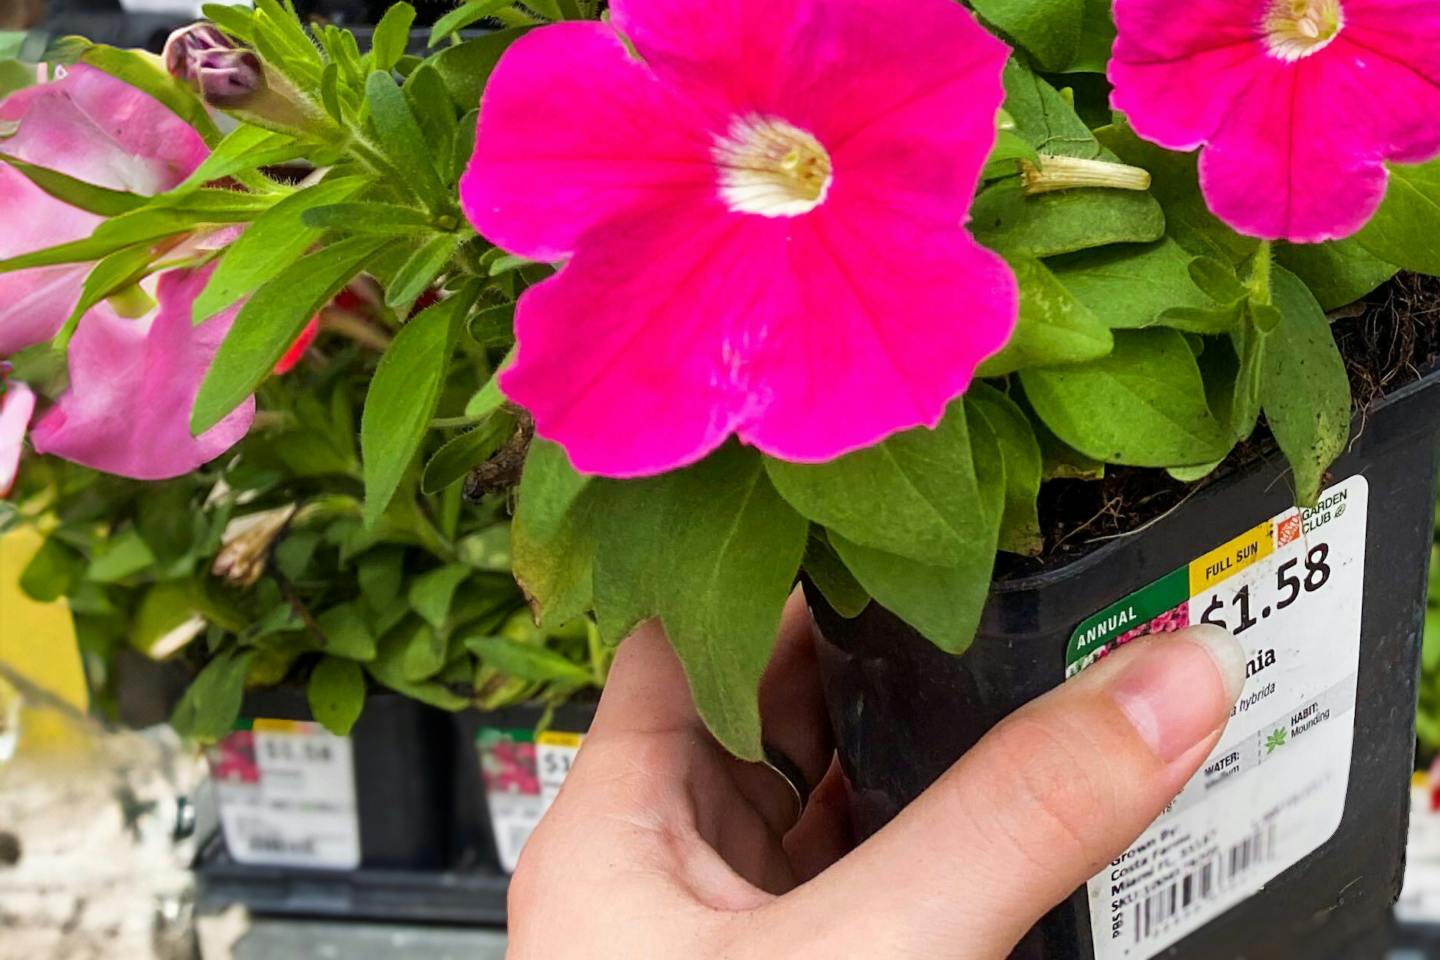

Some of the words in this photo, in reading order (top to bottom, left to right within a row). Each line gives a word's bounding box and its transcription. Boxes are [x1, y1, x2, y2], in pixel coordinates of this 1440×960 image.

[1302, 489, 1347, 521] GARDEN
[1303, 511, 1331, 534] CLUB
[1205, 557, 1232, 580] FULL
[1236, 541, 1258, 563] SUN
[1076, 606, 1137, 651] ANNUAL
[1239, 682, 1276, 712] hybrida
[1291, 708, 1330, 738] Mounding
